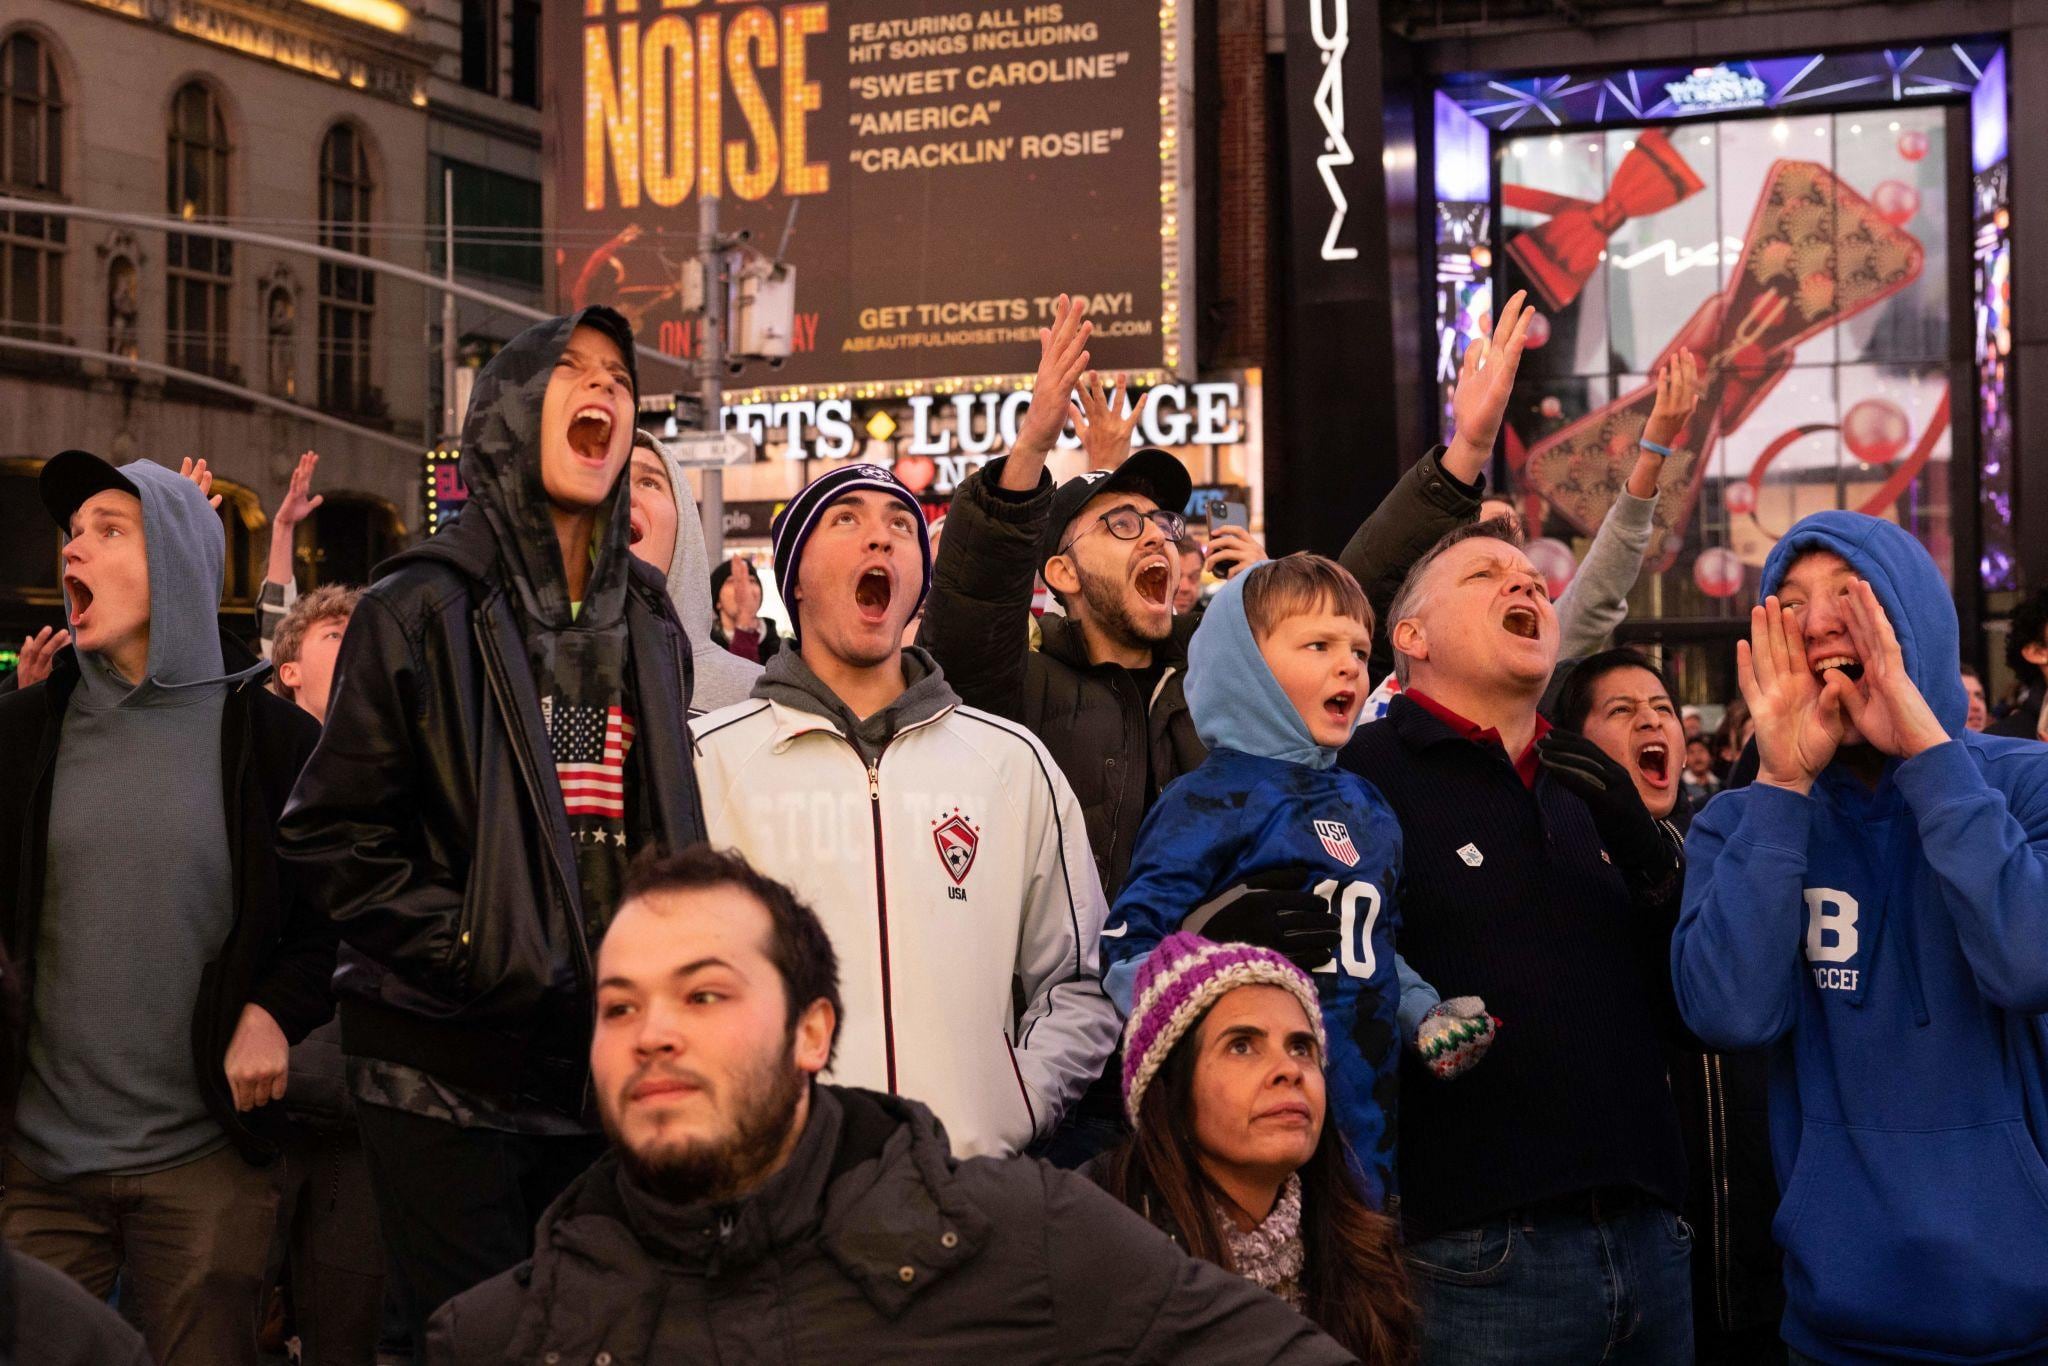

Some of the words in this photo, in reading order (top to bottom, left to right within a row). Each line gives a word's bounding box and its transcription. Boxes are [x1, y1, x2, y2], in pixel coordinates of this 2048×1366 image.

[849, 13, 973, 43] FEATURING
[976, 10, 1020, 29] ALL
[1024, 3, 1063, 25] HIS
[849, 43, 885, 64] HIT
[889, 35, 968, 60] SONGS
[973, 22, 1099, 52] INCLUDING
[849, 68, 962, 99] “SWEET
[966, 52, 1131, 90] CAROLINE”
[583, 2, 830, 211] NOISE
[849, 100, 1002, 137] “AMERICA”
[1021, 127, 1124, 160] ROSIE”
[859, 306, 912, 330] GET
[916, 300, 1029, 325] TICKETS
[659, 320, 691, 357] ON
[664, 399, 855, 461] FTS
[1316, 822, 1347, 842] USA
[947, 886, 967, 902] USA
[1803, 887, 1859, 963] B
